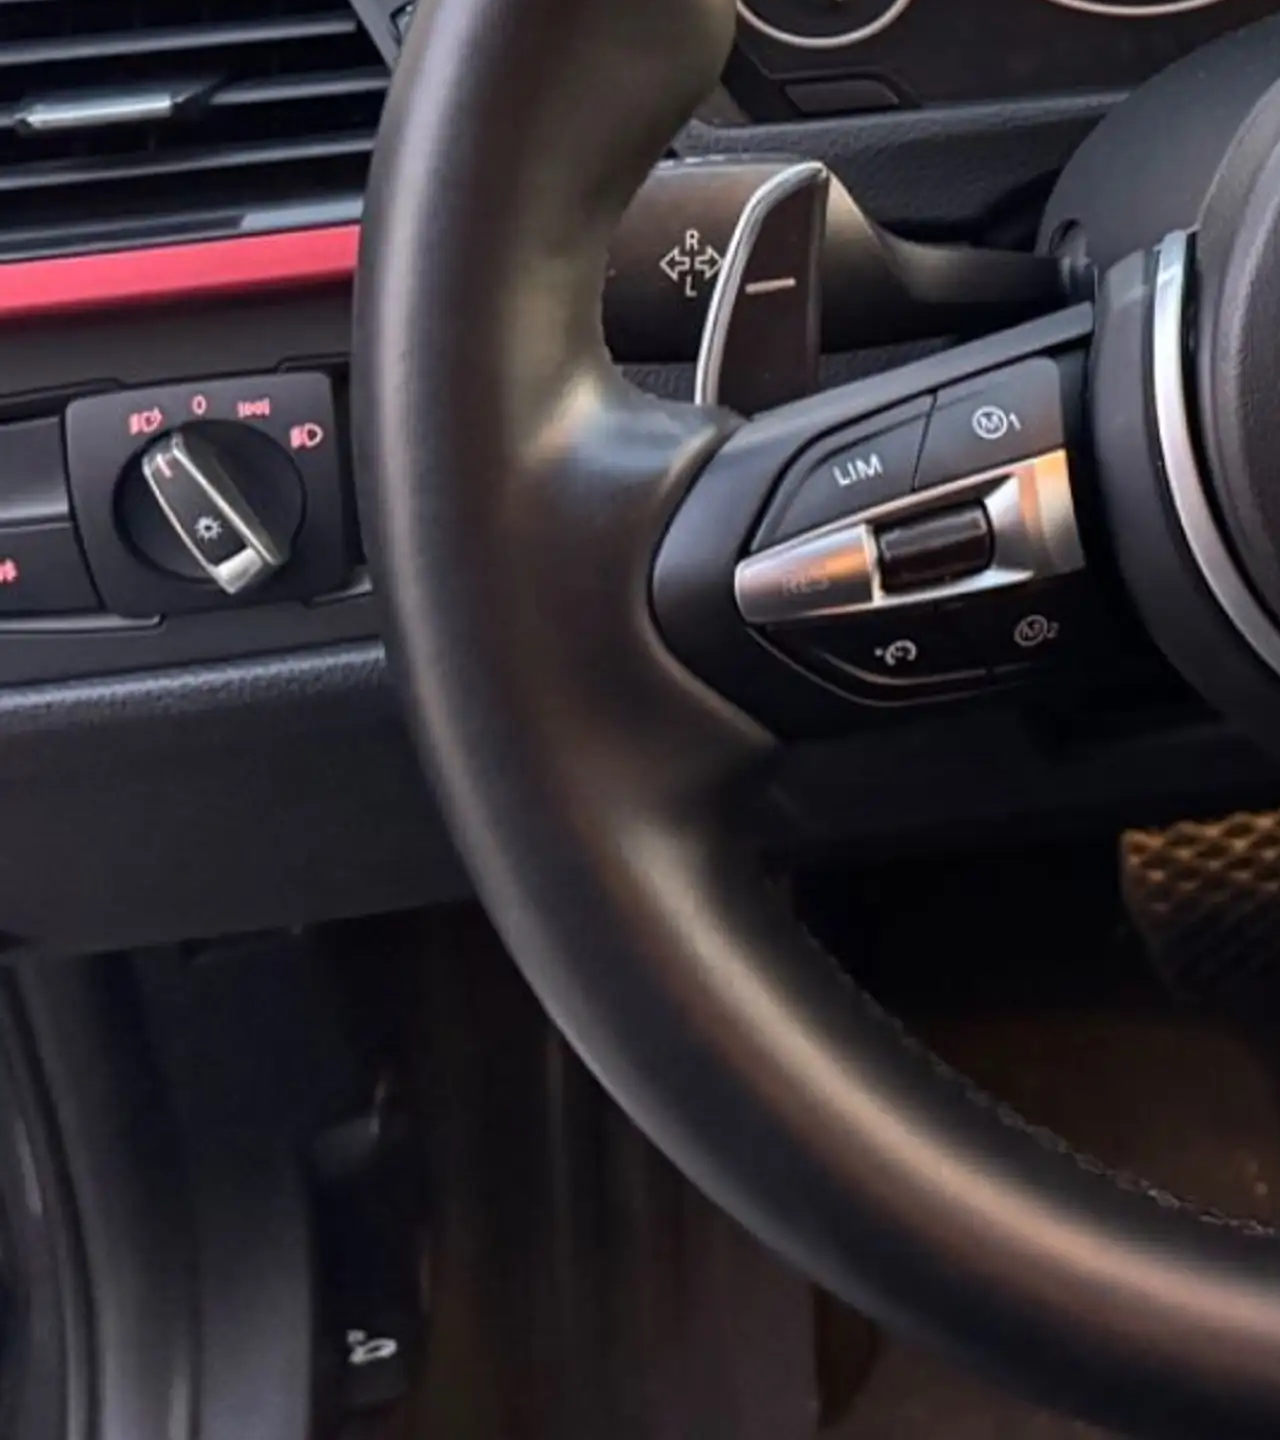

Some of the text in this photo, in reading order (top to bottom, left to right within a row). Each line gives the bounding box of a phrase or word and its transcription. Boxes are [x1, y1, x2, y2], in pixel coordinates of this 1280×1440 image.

[685, 228, 700, 250] R
[686, 275, 698, 298] L
[191, 394, 208, 416] 0
[832, 452, 884, 488] LIM
